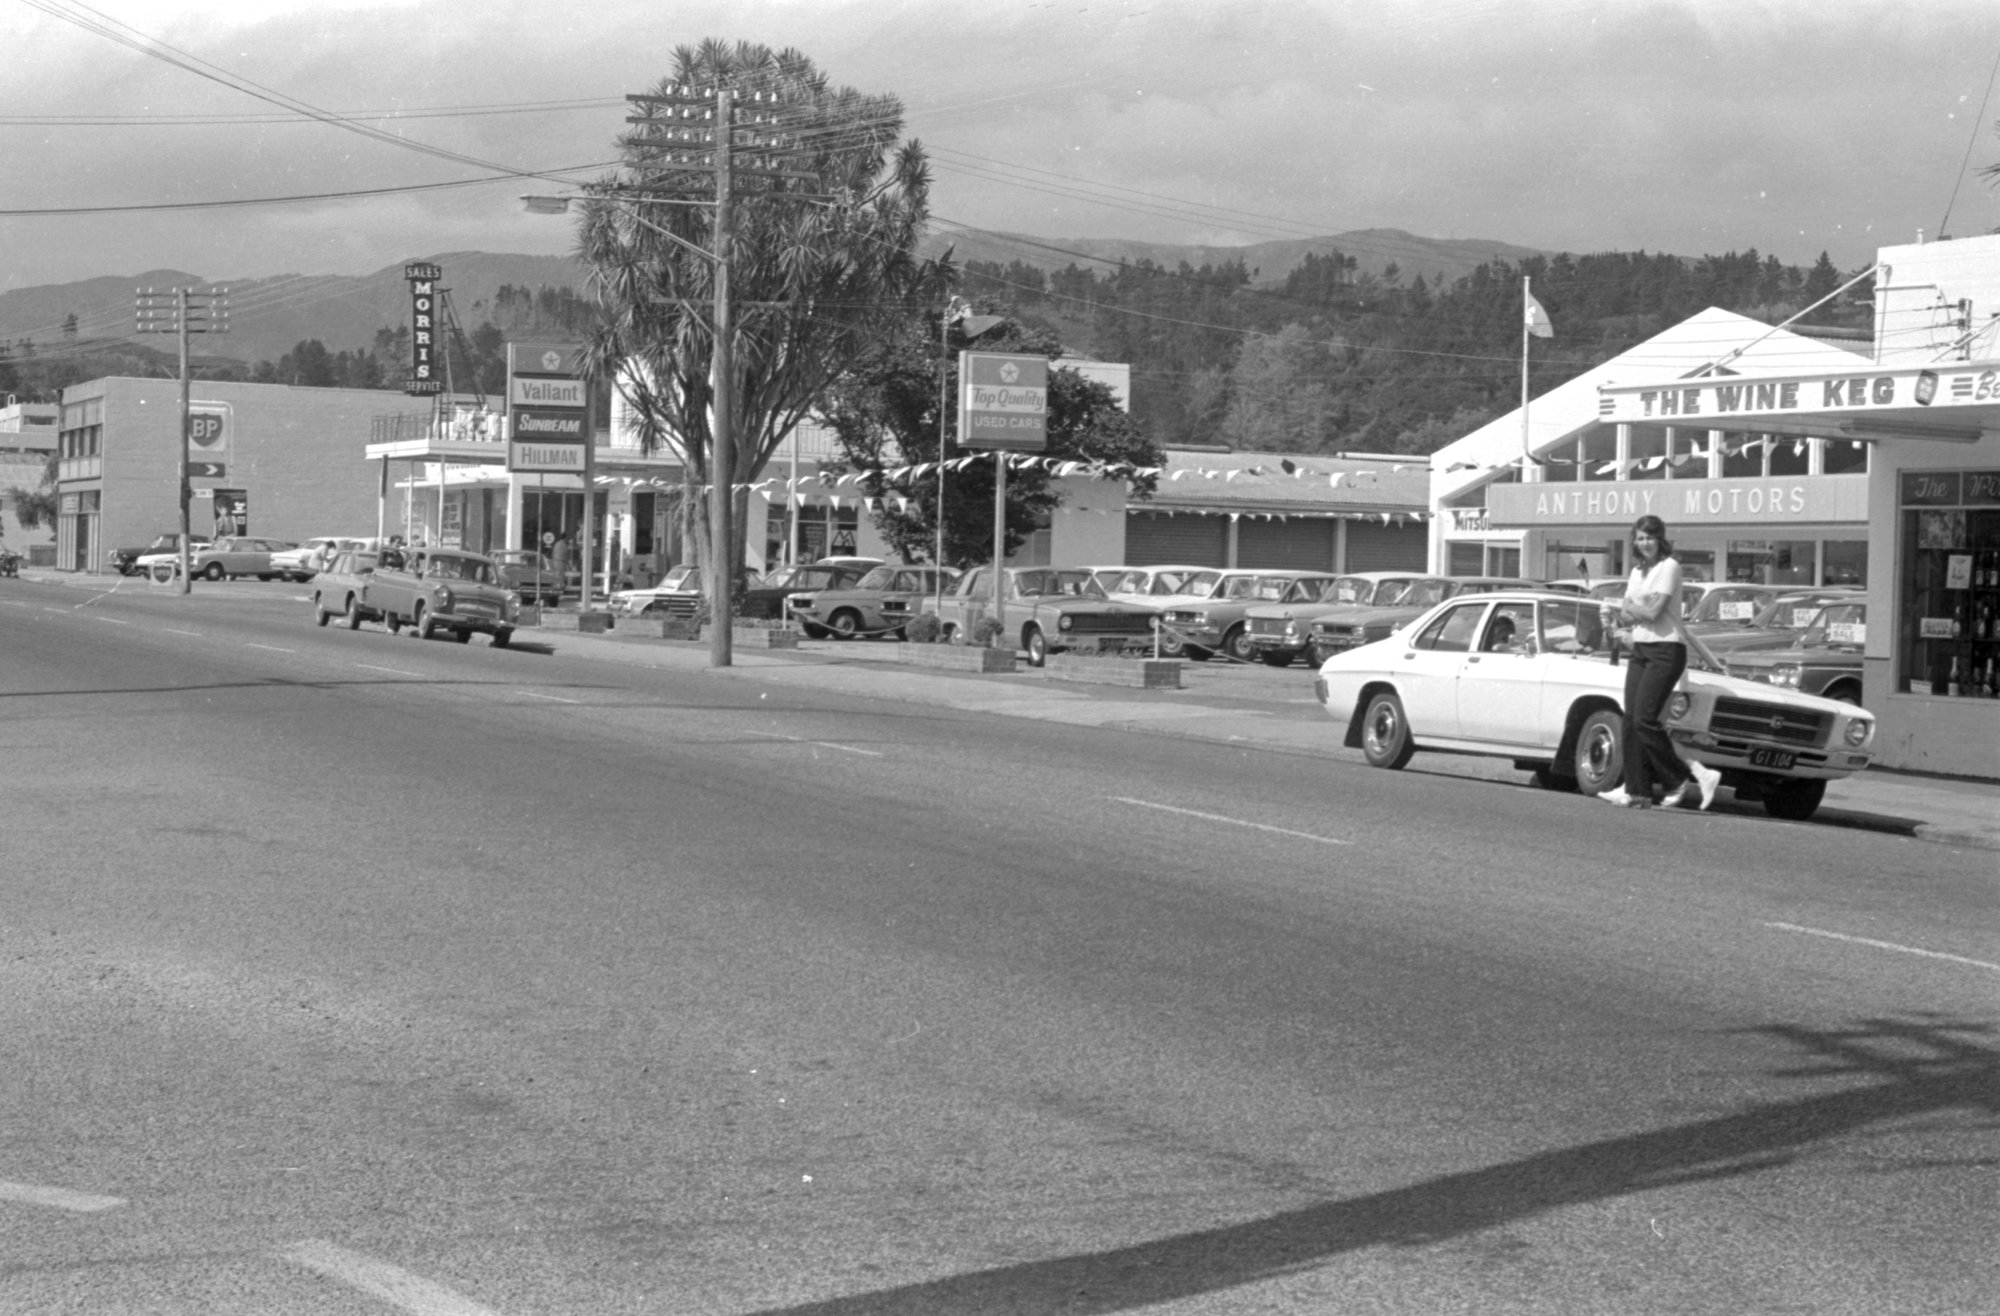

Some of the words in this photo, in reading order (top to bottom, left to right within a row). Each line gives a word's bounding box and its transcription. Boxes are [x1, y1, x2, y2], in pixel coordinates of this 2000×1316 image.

[406, 266, 440, 278] SALES
[414, 281, 432, 378] MORRIS
[406, 381, 440, 392] SERVICE
[521, 382, 579, 401] Valiant
[972, 388, 996, 409] Top
[997, 388, 1044, 412] Quality
[1640, 387, 1701, 417] THE
[1715, 381, 1800, 412] WINE
[1822, 376, 1895, 408] KEG
[192, 419, 219, 438] BP
[519, 413, 581, 433] SUNBEAM
[974, 416, 1007, 428] USED
[1009, 417, 1041, 429] CARS
[521, 446, 578, 465] HILLMAN
[1914, 477, 1949, 498] The
[1536, 489, 1655, 515] ANTHONY
[1685, 486, 1806, 515] MOTORS
